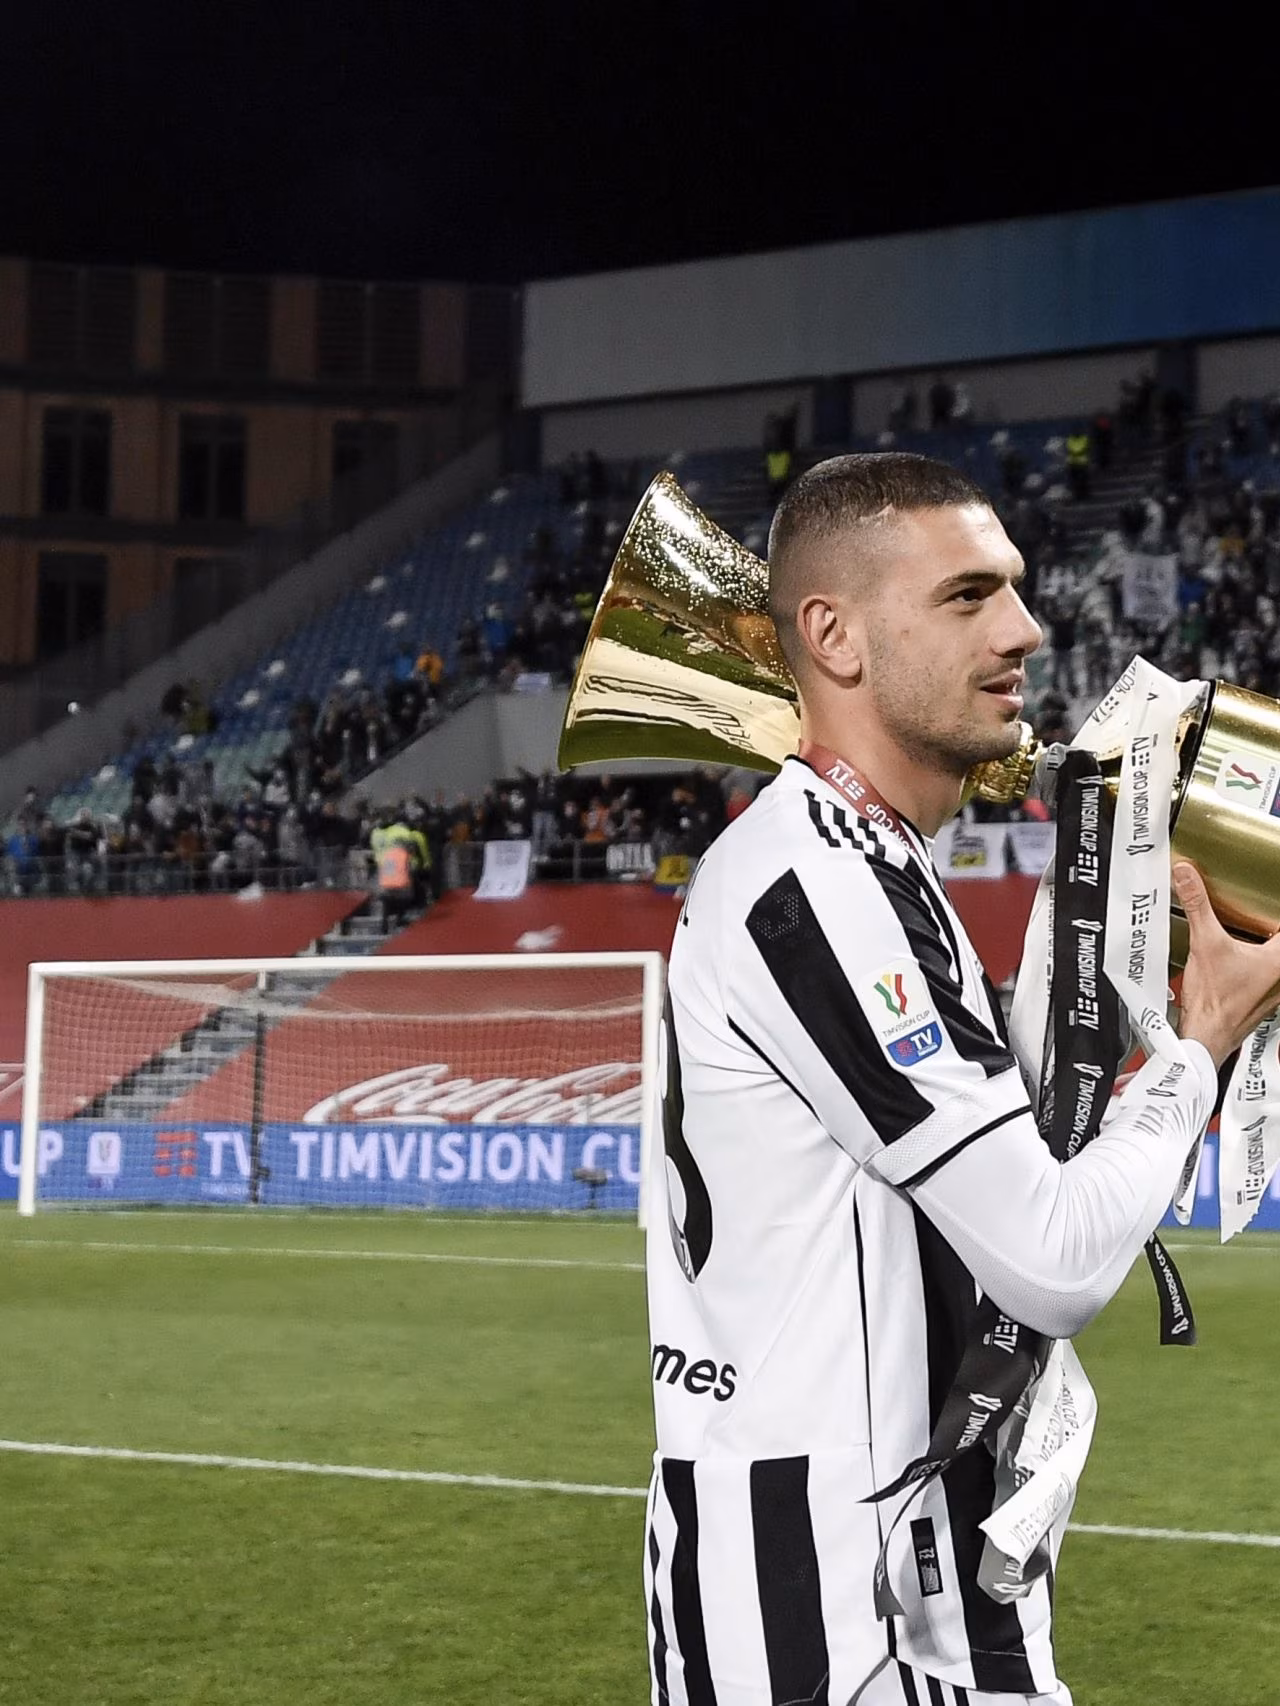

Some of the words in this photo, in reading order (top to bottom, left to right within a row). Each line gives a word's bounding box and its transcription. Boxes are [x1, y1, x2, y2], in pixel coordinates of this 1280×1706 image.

[1132, 771, 1148, 790] CUP
[1080, 786, 1099, 831] TIMVISION
[1132, 790, 1149, 841] TIMVISION
[1080, 831, 1098, 852] CUP
[1078, 933, 1097, 979] TIMVISION
[1131, 929, 1147, 948] CUP
[1128, 949, 1146, 984] VISION
[1078, 979, 1096, 998] CUP
[915, 1010, 930, 1022] CUP
[910, 1028, 932, 1049] TV
[1072, 1077, 1096, 1135] TIMVISION
[203, 1131, 265, 1177] TV
[291, 1132, 564, 1182] TIMVISION
[582, 1133, 641, 1182] CU
